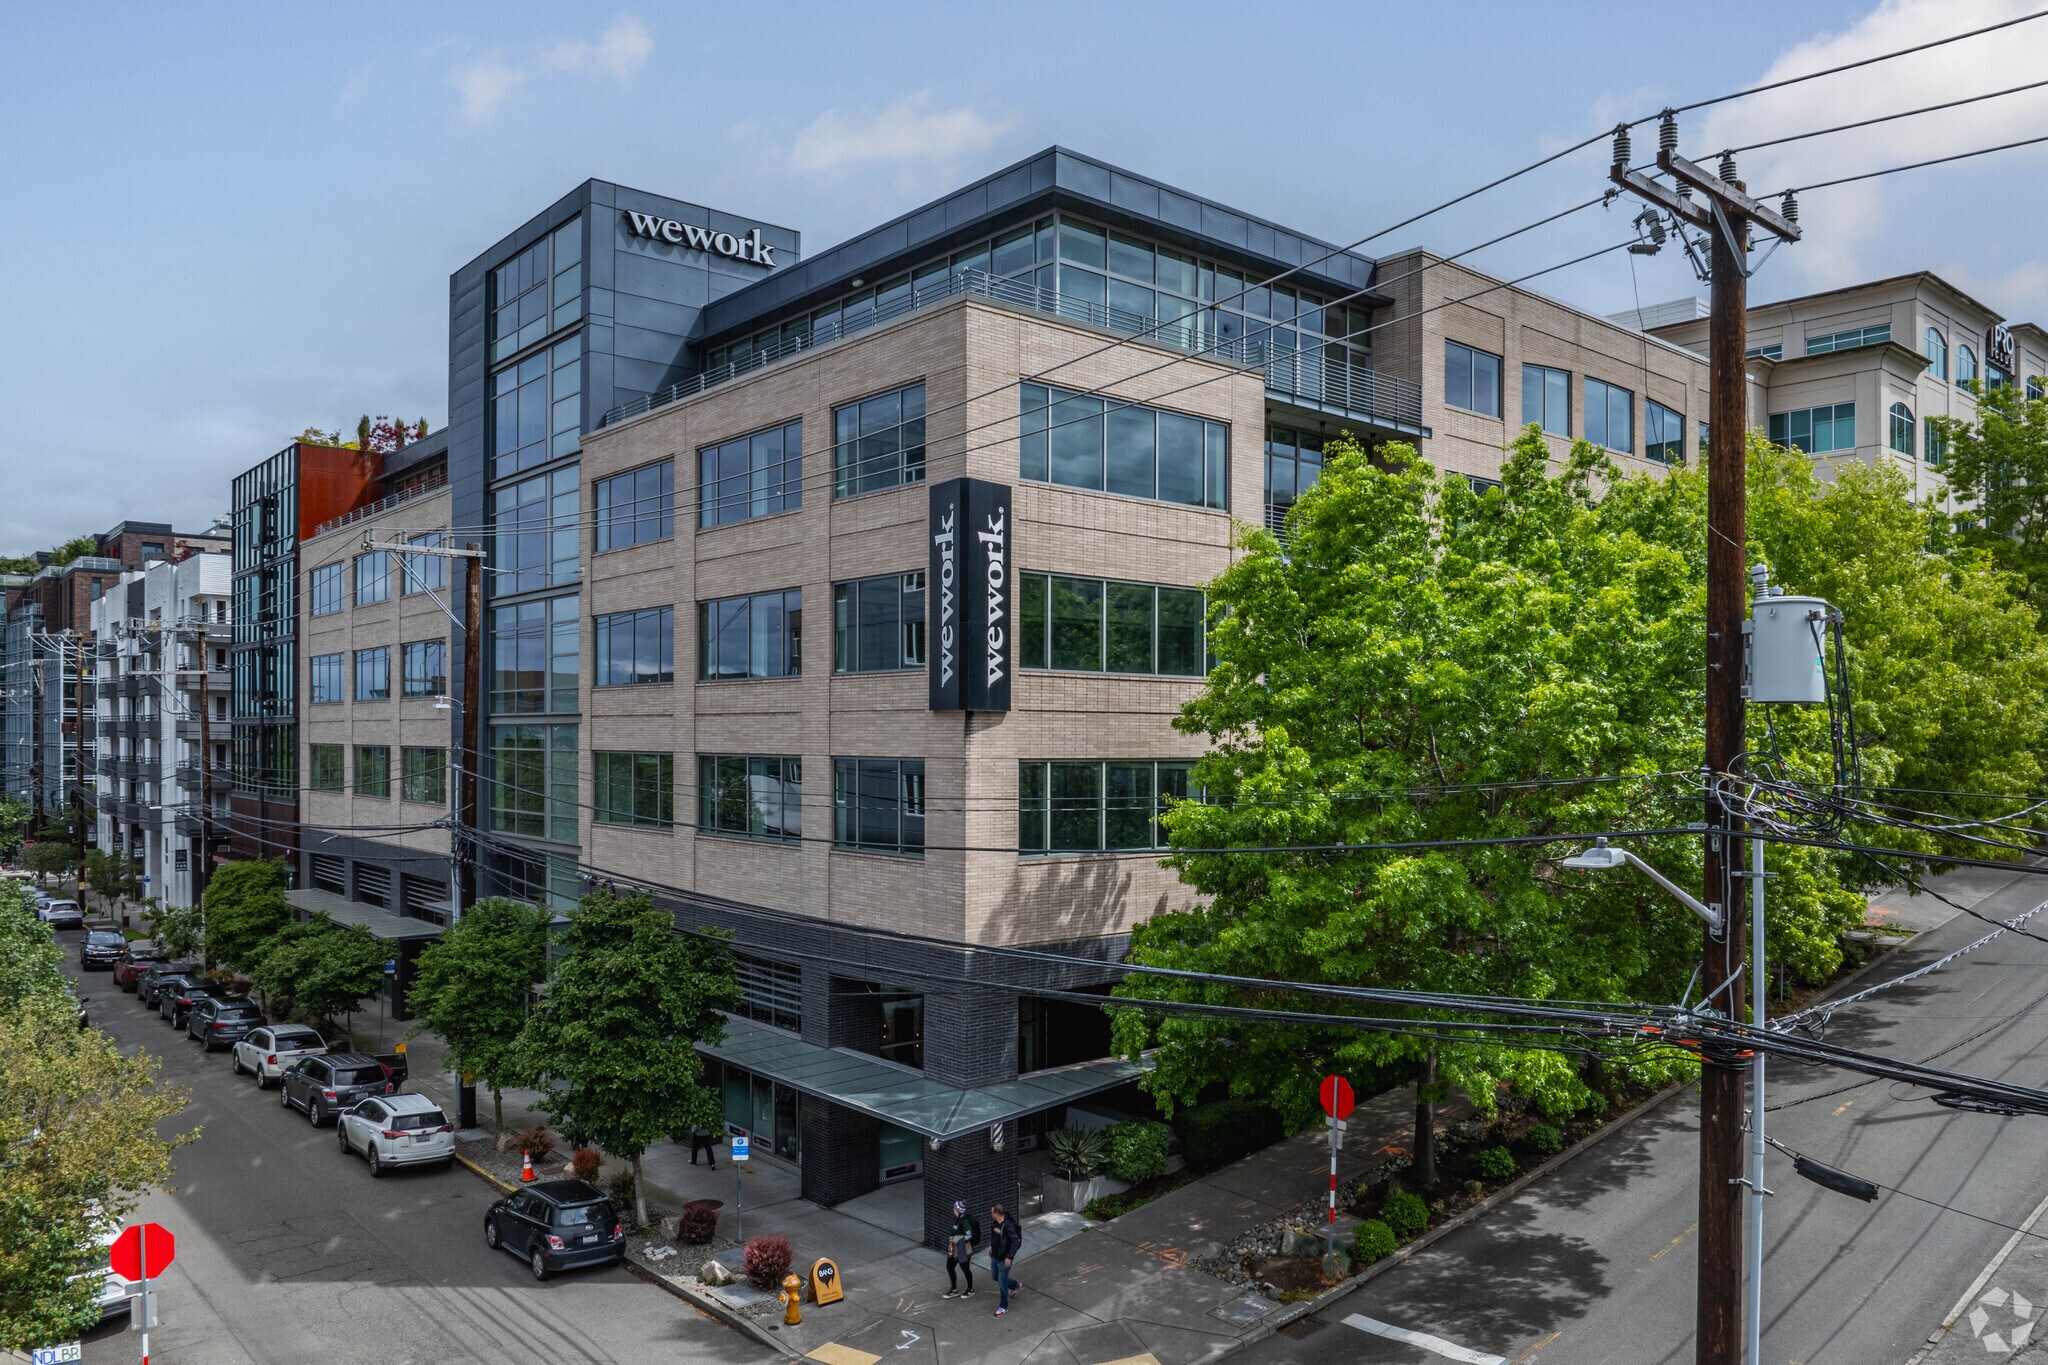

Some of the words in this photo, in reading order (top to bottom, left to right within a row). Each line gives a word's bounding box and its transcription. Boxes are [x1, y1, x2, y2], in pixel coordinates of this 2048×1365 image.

[627, 210, 777, 267] wework
[935, 510, 954, 687] wework
[978, 514, 1004, 687] wework
[818, 1268, 834, 1277] BANG
